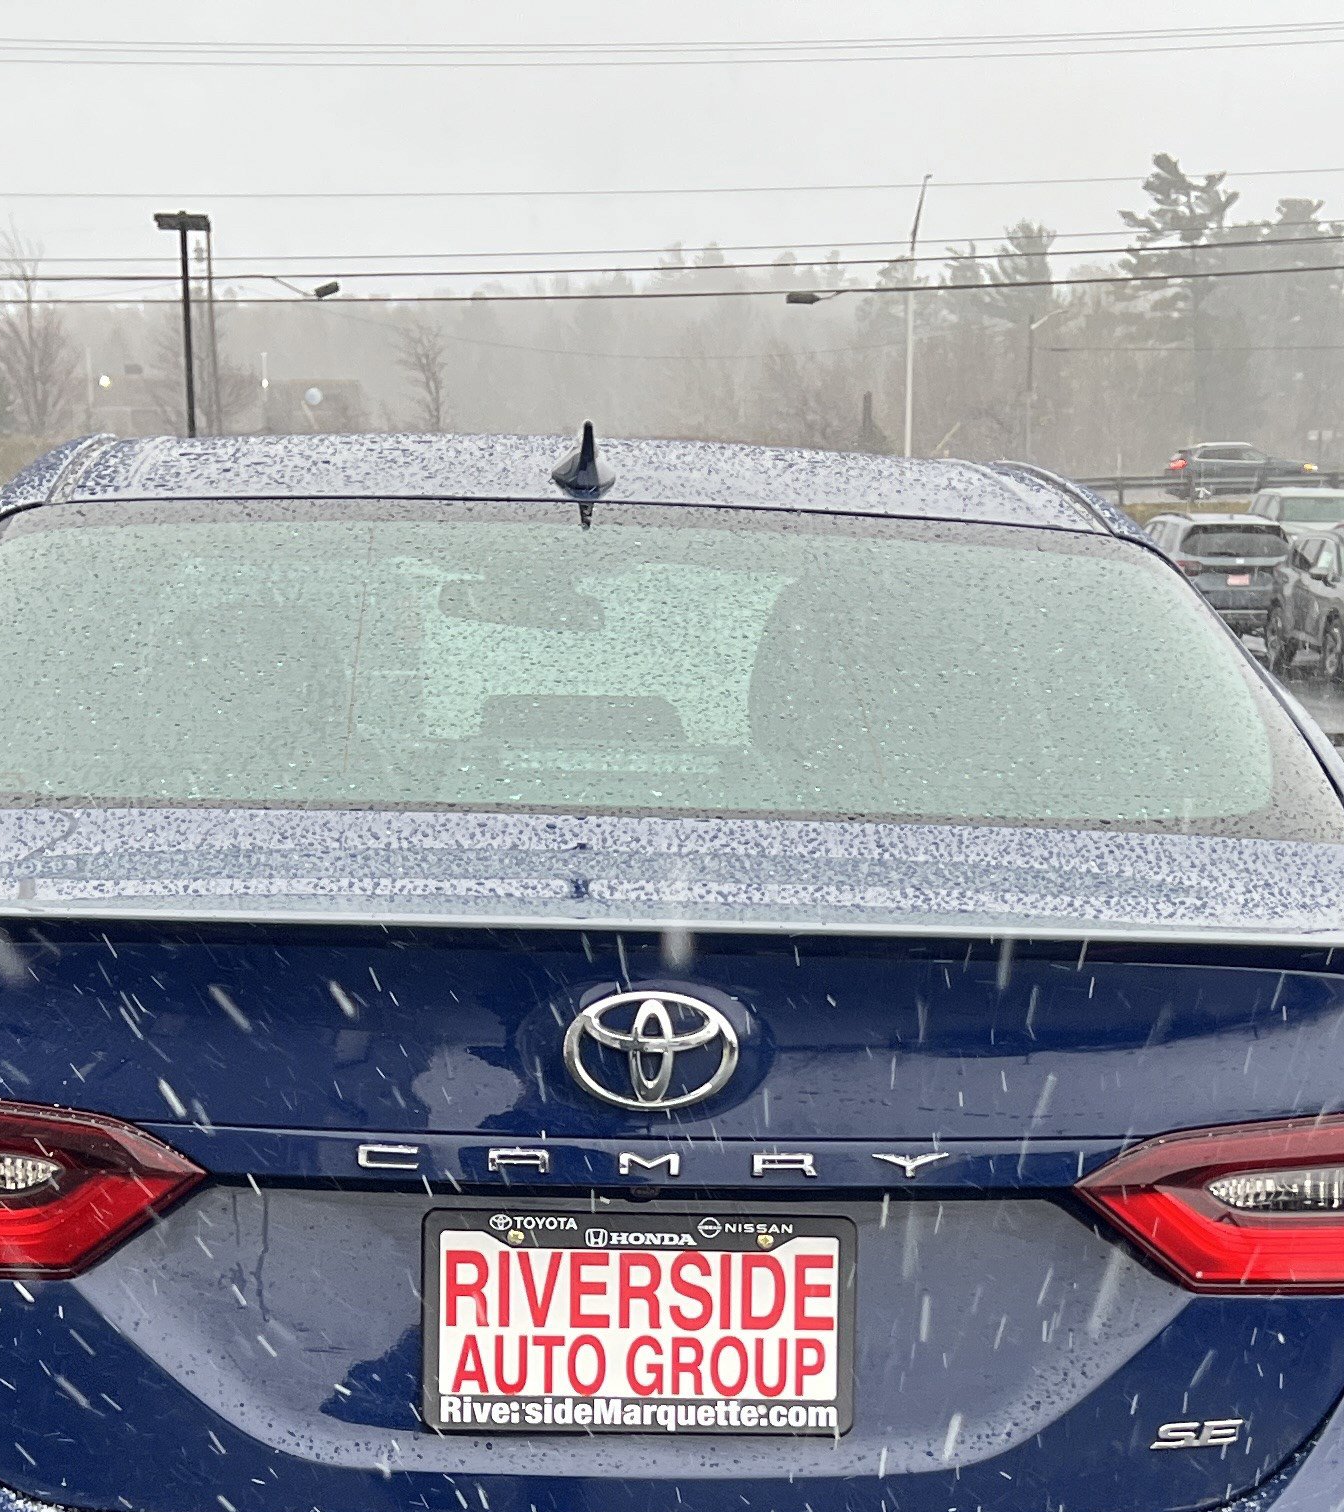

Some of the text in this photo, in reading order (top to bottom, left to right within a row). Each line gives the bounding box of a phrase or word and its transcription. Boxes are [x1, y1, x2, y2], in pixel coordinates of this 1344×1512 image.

[357, 1144, 950, 1178] CAMRY
[512, 1215, 578, 1230] TOYOTA
[724, 1222, 793, 1234] NISSAN
[609, 1231, 697, 1246] HONDA
[444, 1250, 834, 1331] RIVERSIDE
[451, 1334, 825, 1397] AUTO GROUP
[1150, 1418, 1243, 1449] SE
